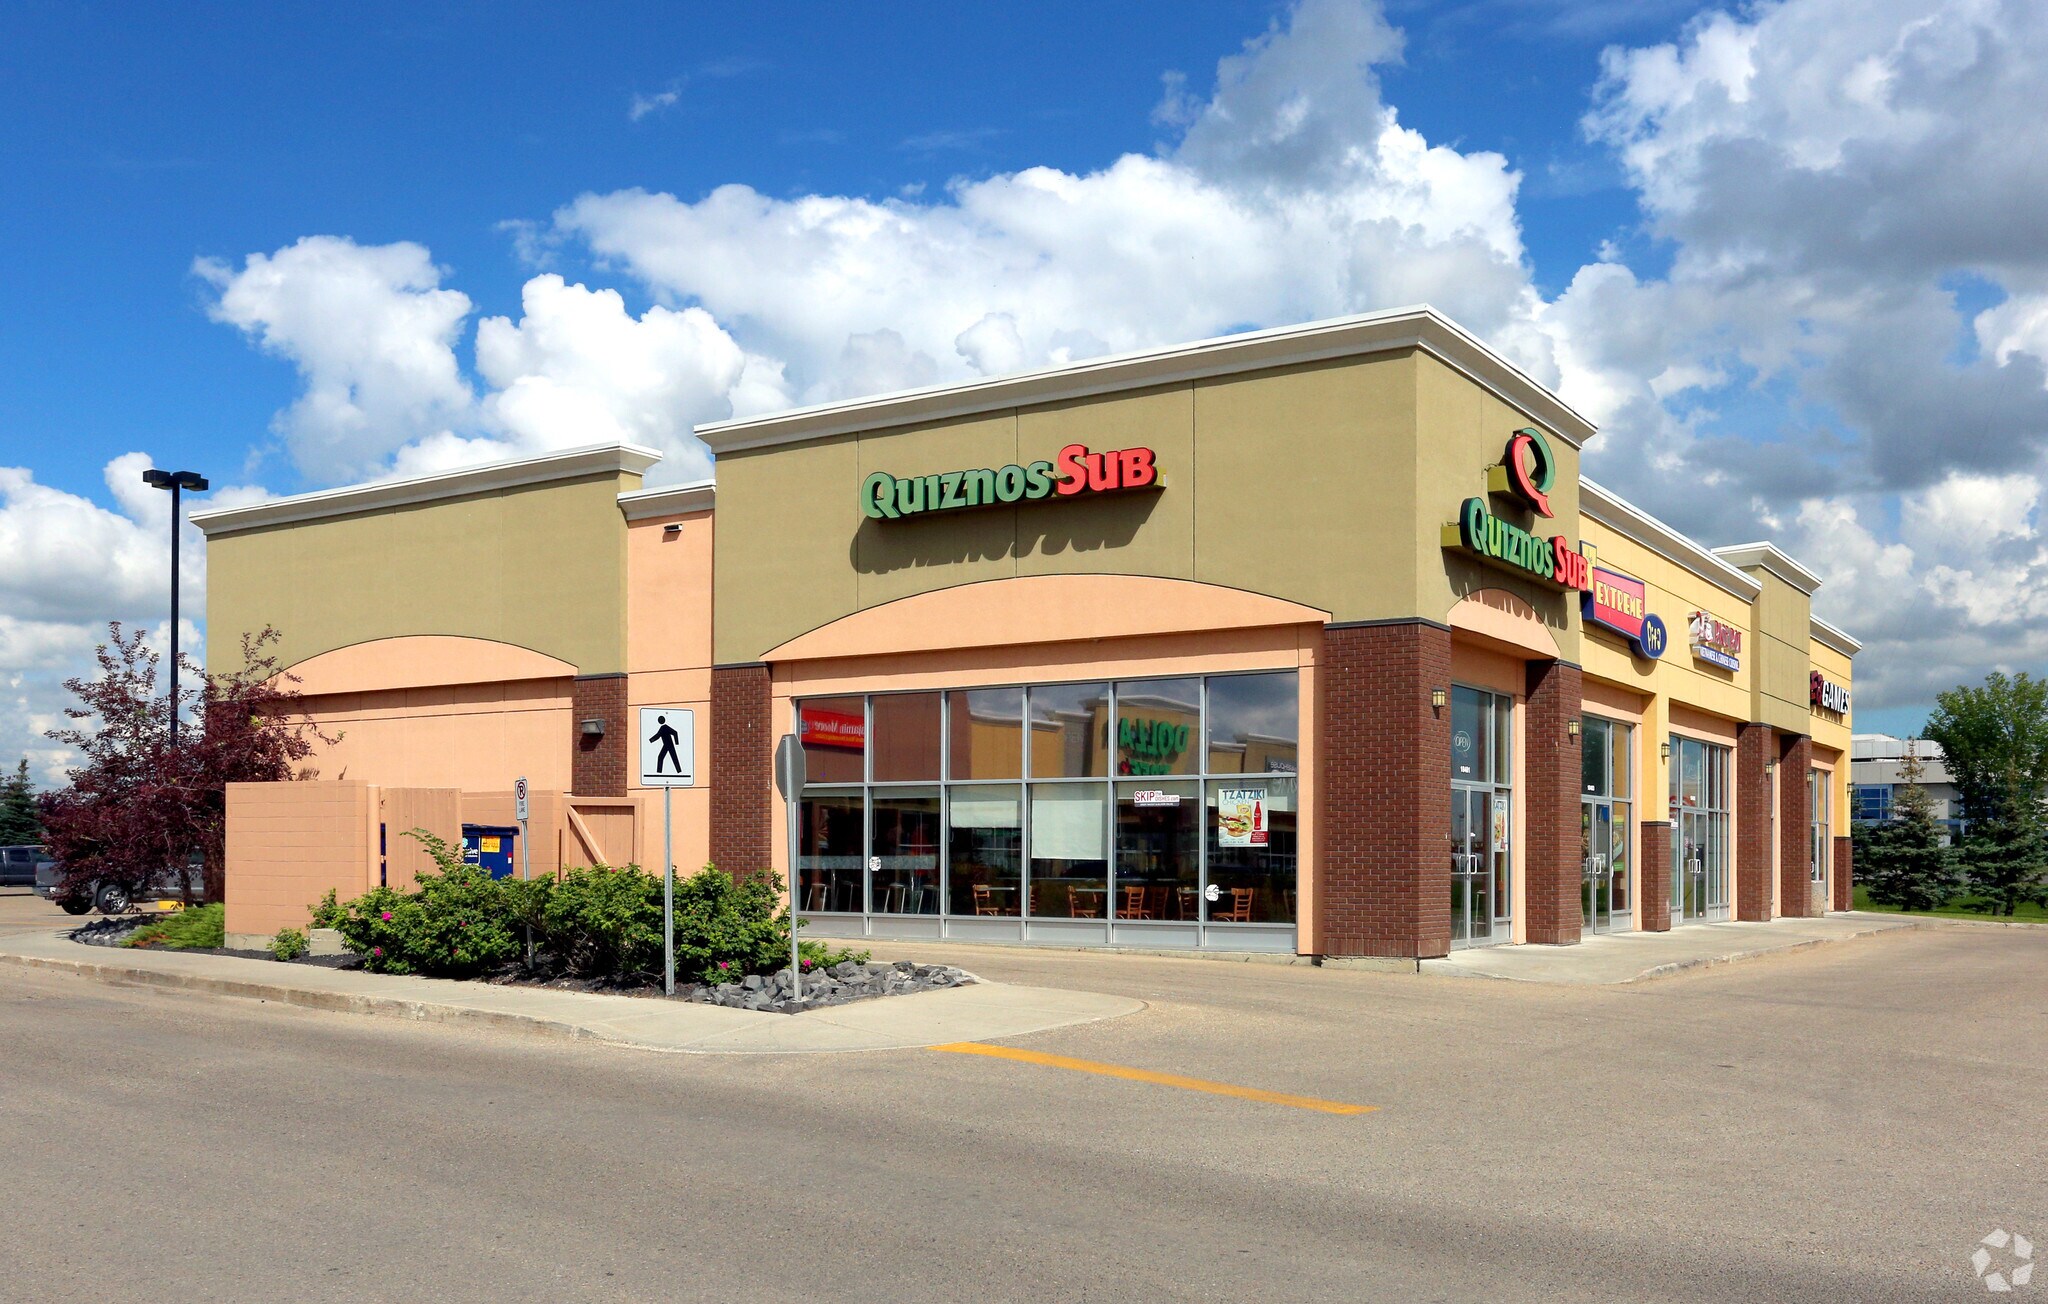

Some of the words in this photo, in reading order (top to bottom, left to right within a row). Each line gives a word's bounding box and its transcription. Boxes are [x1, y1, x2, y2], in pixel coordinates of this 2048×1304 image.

[1595, 579, 1643, 621] EXTREME
[1822, 680, 1851, 715] GAMES
[1135, 791, 1155, 802] SKIP
[1222, 789, 1266, 800] TZATZIKI
